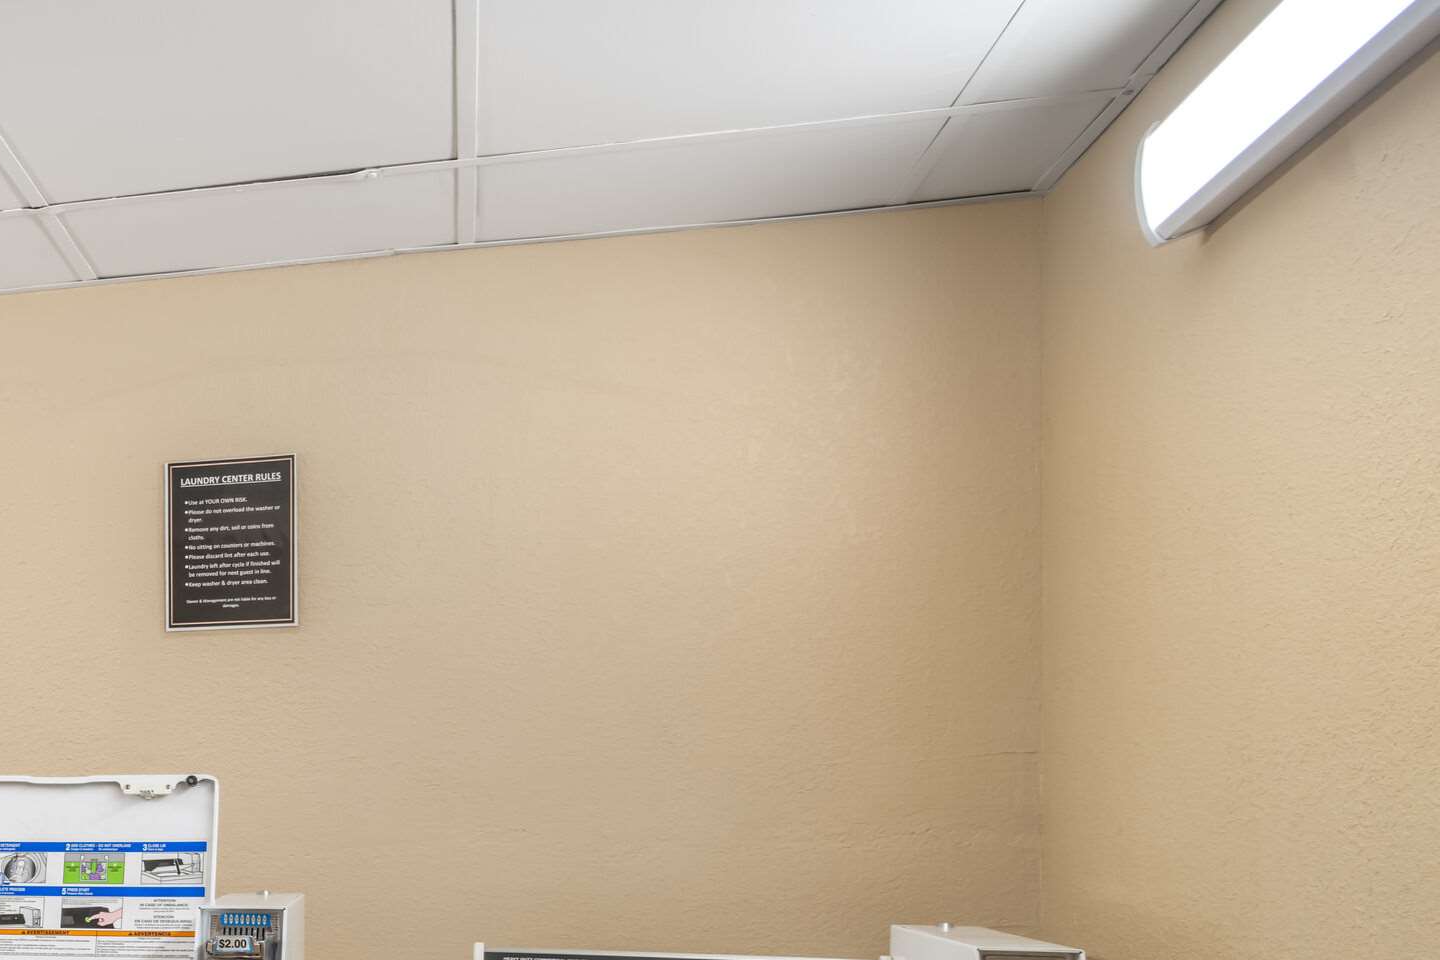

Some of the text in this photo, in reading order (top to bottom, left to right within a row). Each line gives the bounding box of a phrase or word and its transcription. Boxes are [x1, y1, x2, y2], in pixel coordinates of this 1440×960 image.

[180, 472, 281, 486] LAUNDRY CENTER RULES
[219, 939, 247, 949] $2.00
